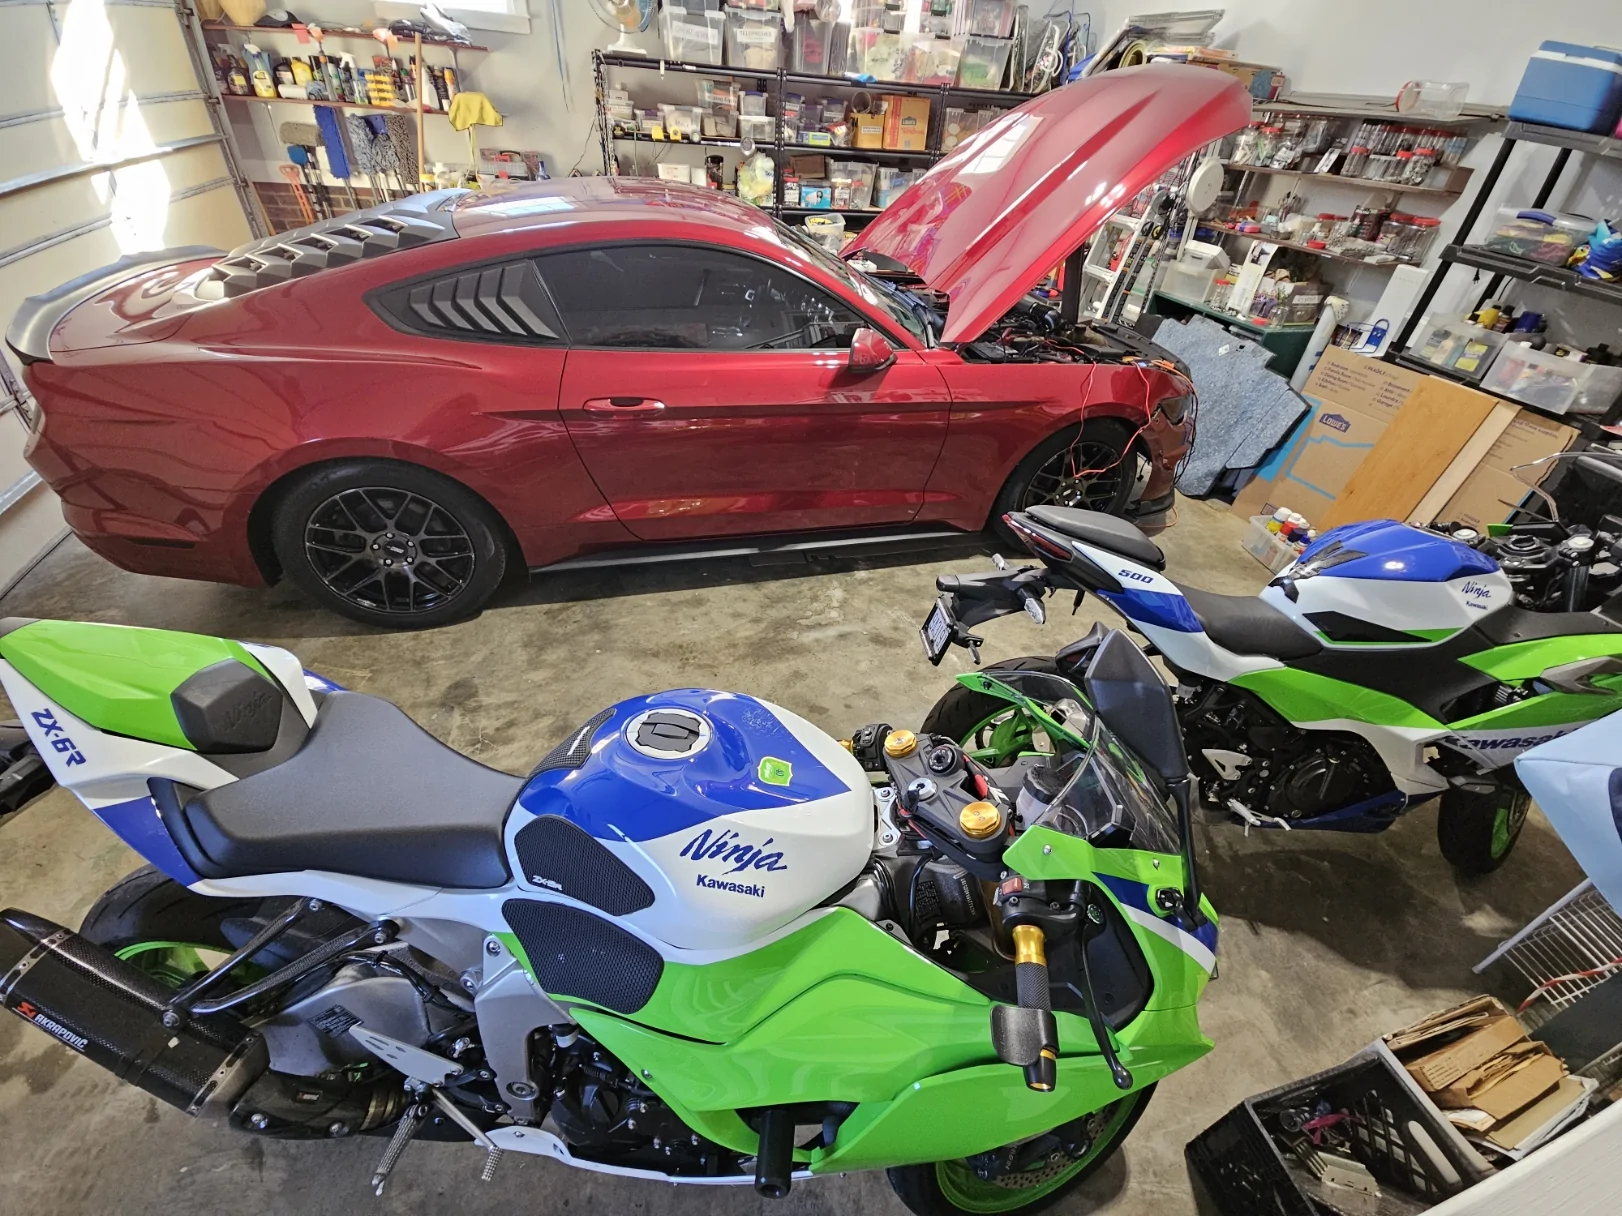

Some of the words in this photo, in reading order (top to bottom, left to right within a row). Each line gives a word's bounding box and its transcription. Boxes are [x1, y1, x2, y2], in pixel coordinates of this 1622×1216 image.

[1118, 569, 1154, 584] 500
[1461, 581, 1492, 600] Ninja
[31, 708, 87, 767] ZX-6R
[1442, 728, 1579, 750] Kawasa
[679, 828, 788, 876] Ninja
[696, 874, 766, 899] Kawasaki
